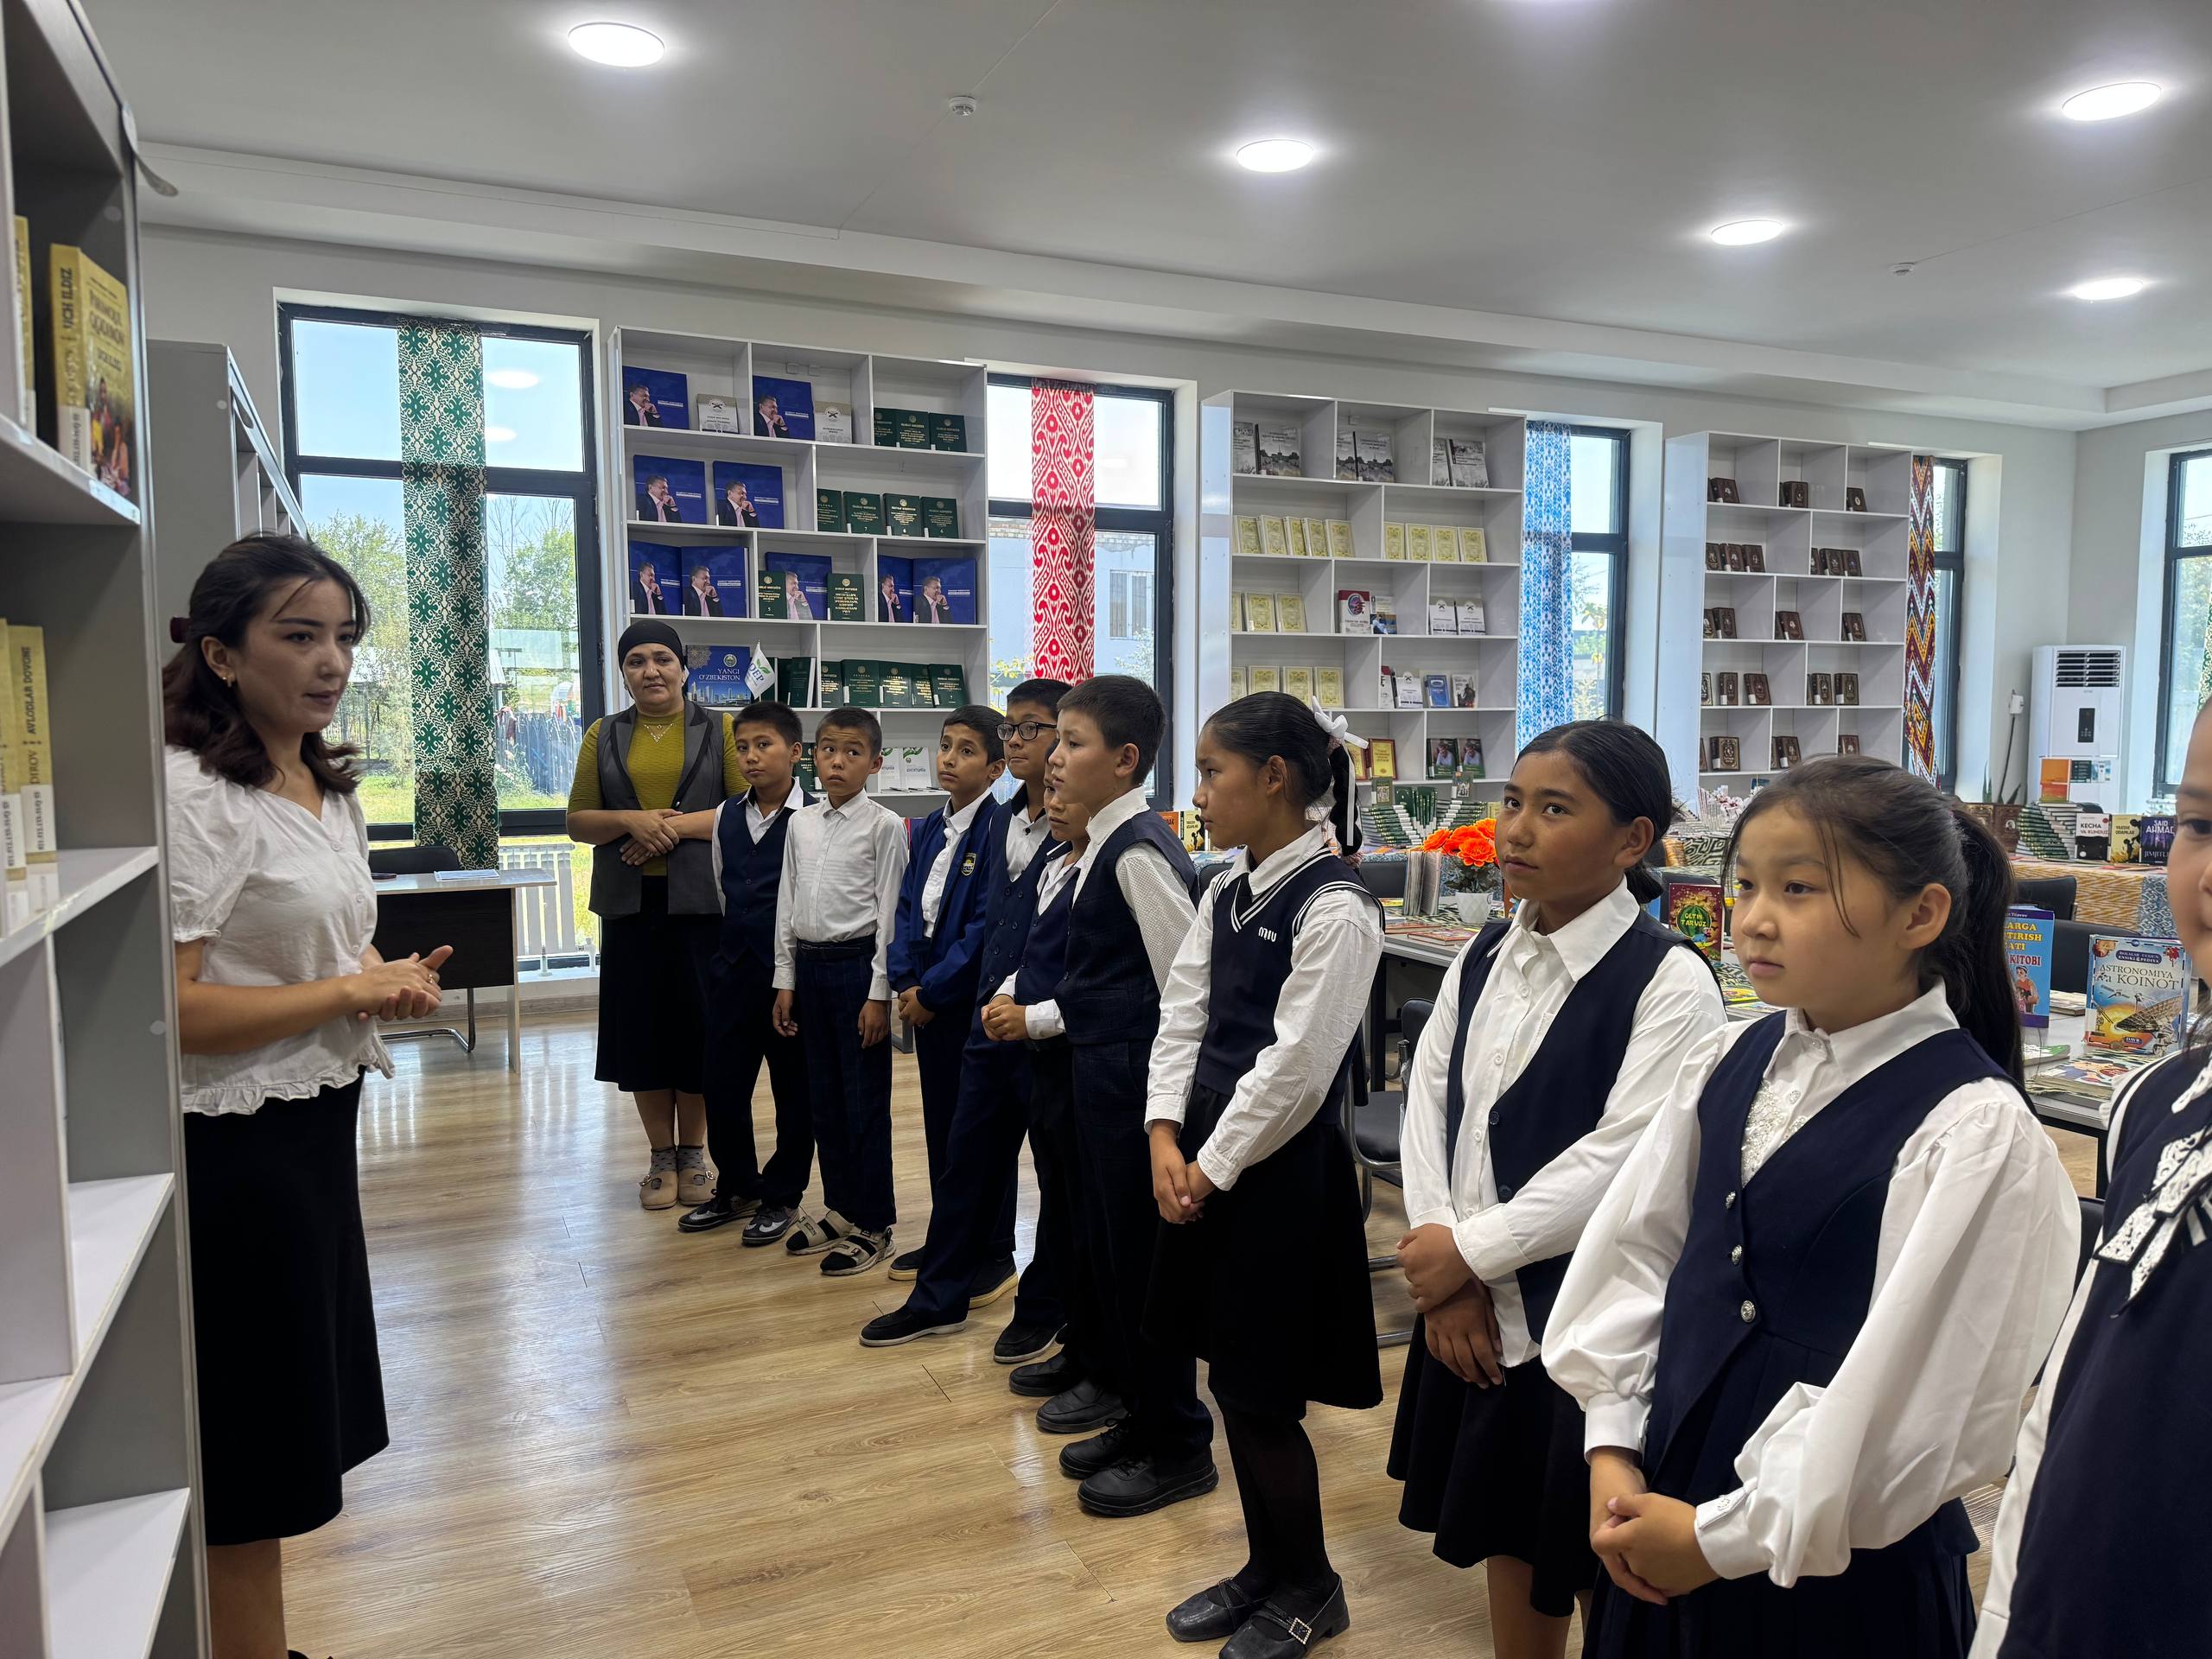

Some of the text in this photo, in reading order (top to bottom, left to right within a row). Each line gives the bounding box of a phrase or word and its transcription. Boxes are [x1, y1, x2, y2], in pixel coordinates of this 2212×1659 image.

[60, 267, 73, 300] ILDIZ
[24, 686, 36, 734] AVLODLAR
[28, 749, 40, 785] DIROV
[2005, 931, 2043, 942] TIRISH
[2009, 954, 2041, 966] KITOBI
[2100, 964, 2173, 979] ASTRONOMIYA
[2117, 974, 2179, 990] KOINOT
